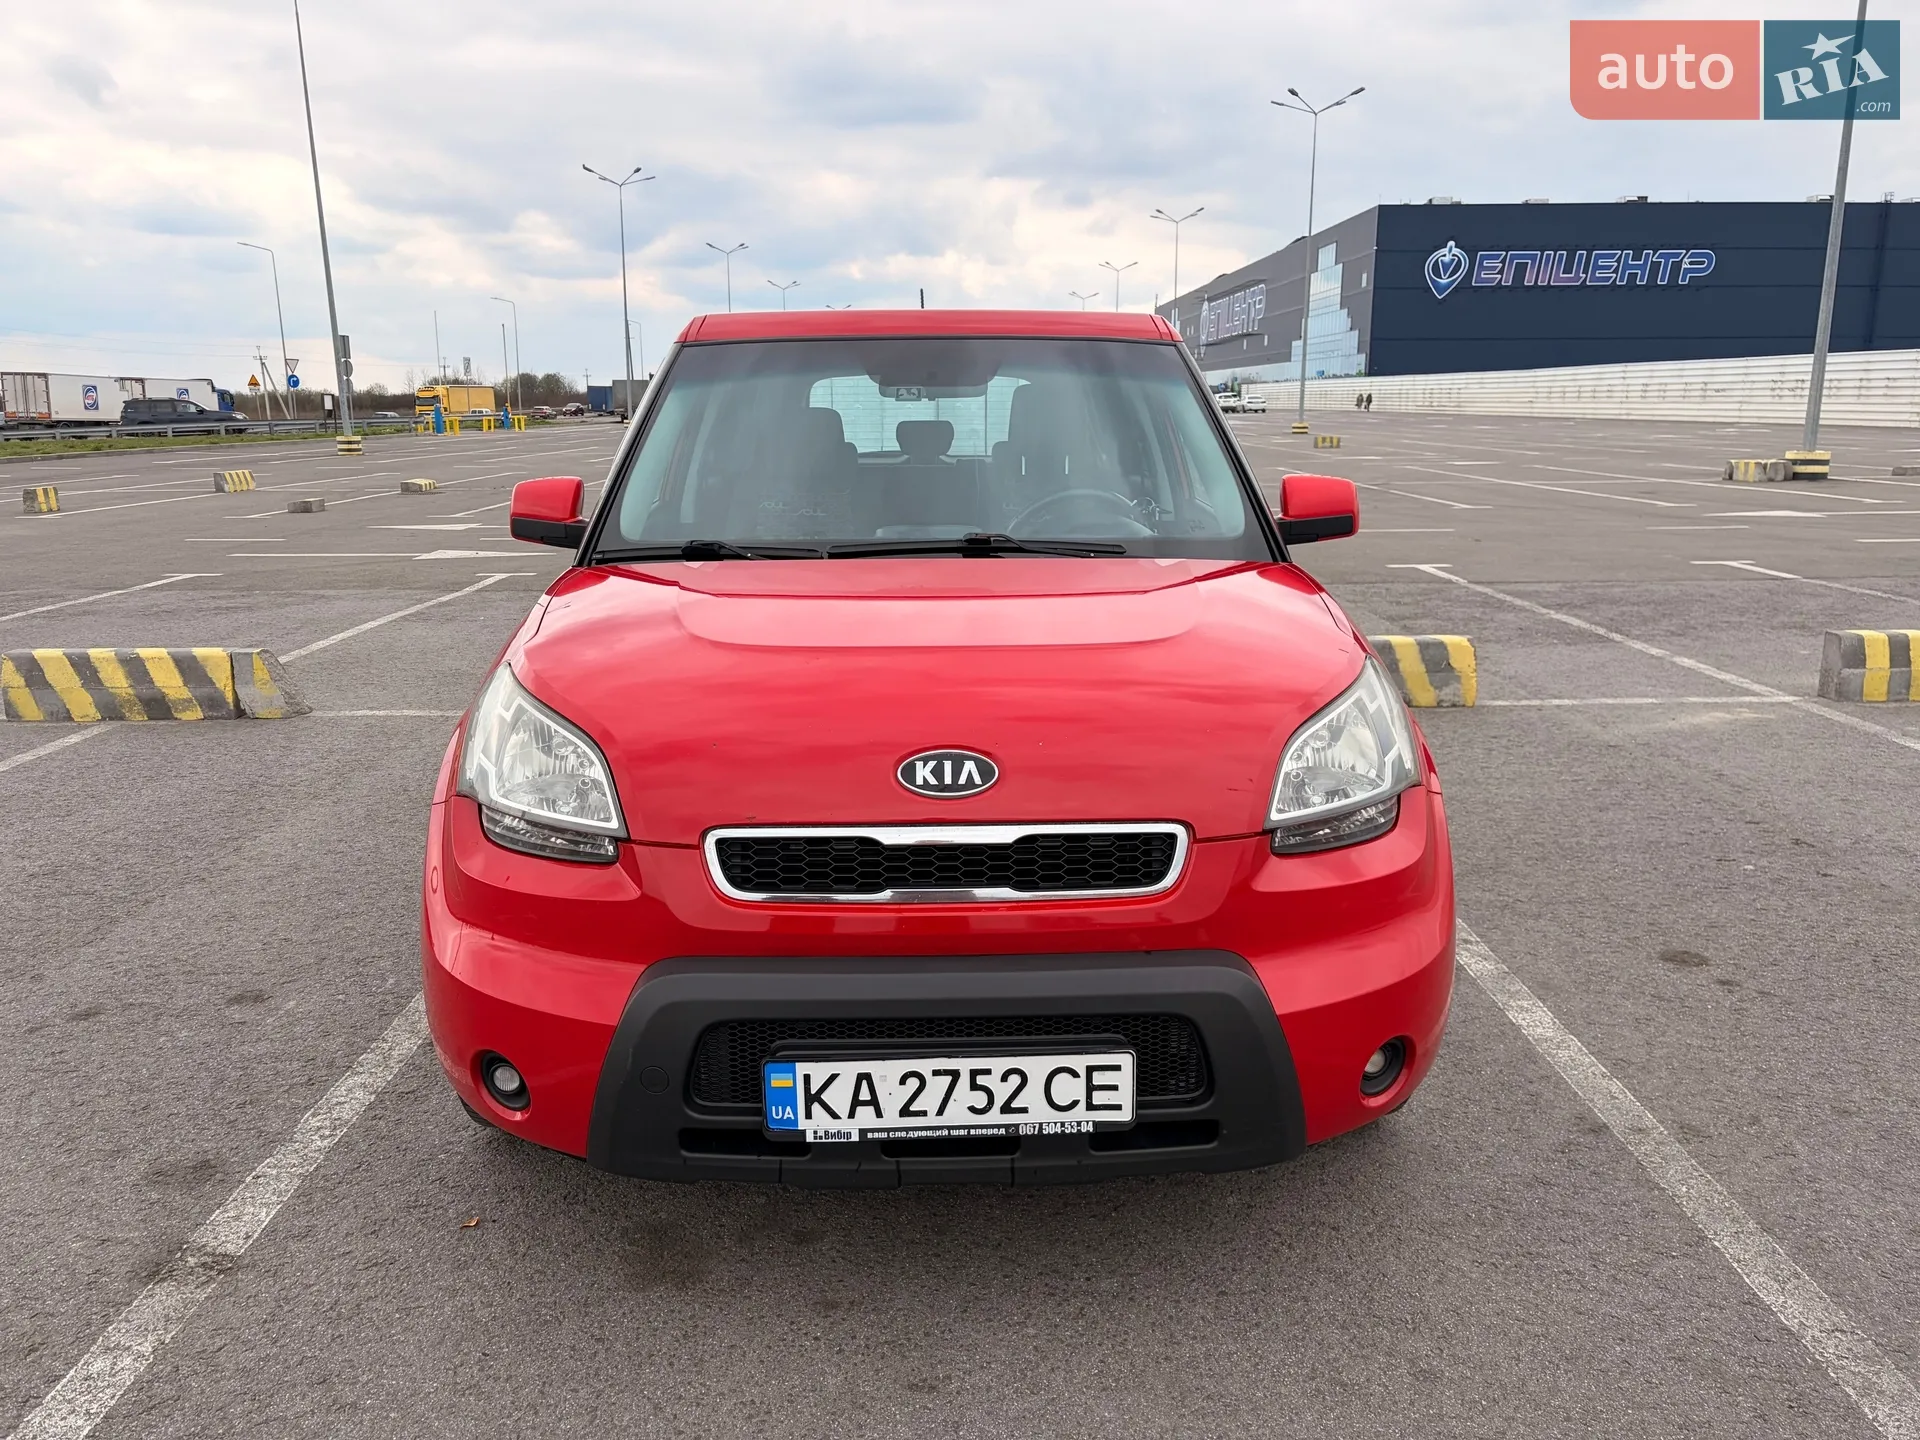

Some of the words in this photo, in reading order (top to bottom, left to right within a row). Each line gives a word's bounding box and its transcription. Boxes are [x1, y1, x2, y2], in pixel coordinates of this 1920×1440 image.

[1471, 249, 1716, 286] ЕПІЦЕНТР
[914, 760, 983, 785] KIA
[803, 1071, 884, 1120] KA
[899, 1068, 1029, 1118] 2752
[1043, 1064, 1123, 1112] CE
[772, 1106, 794, 1120] UA
[824, 1130, 852, 1141] Вибір
[867, 1131, 887, 1139] ваш
[889, 1128, 949, 1139] следующий
[970, 1128, 1006, 1136] вперед
[1019, 1123, 1040, 1136] 067
[1042, 1121, 1094, 1134] 504-53-04
